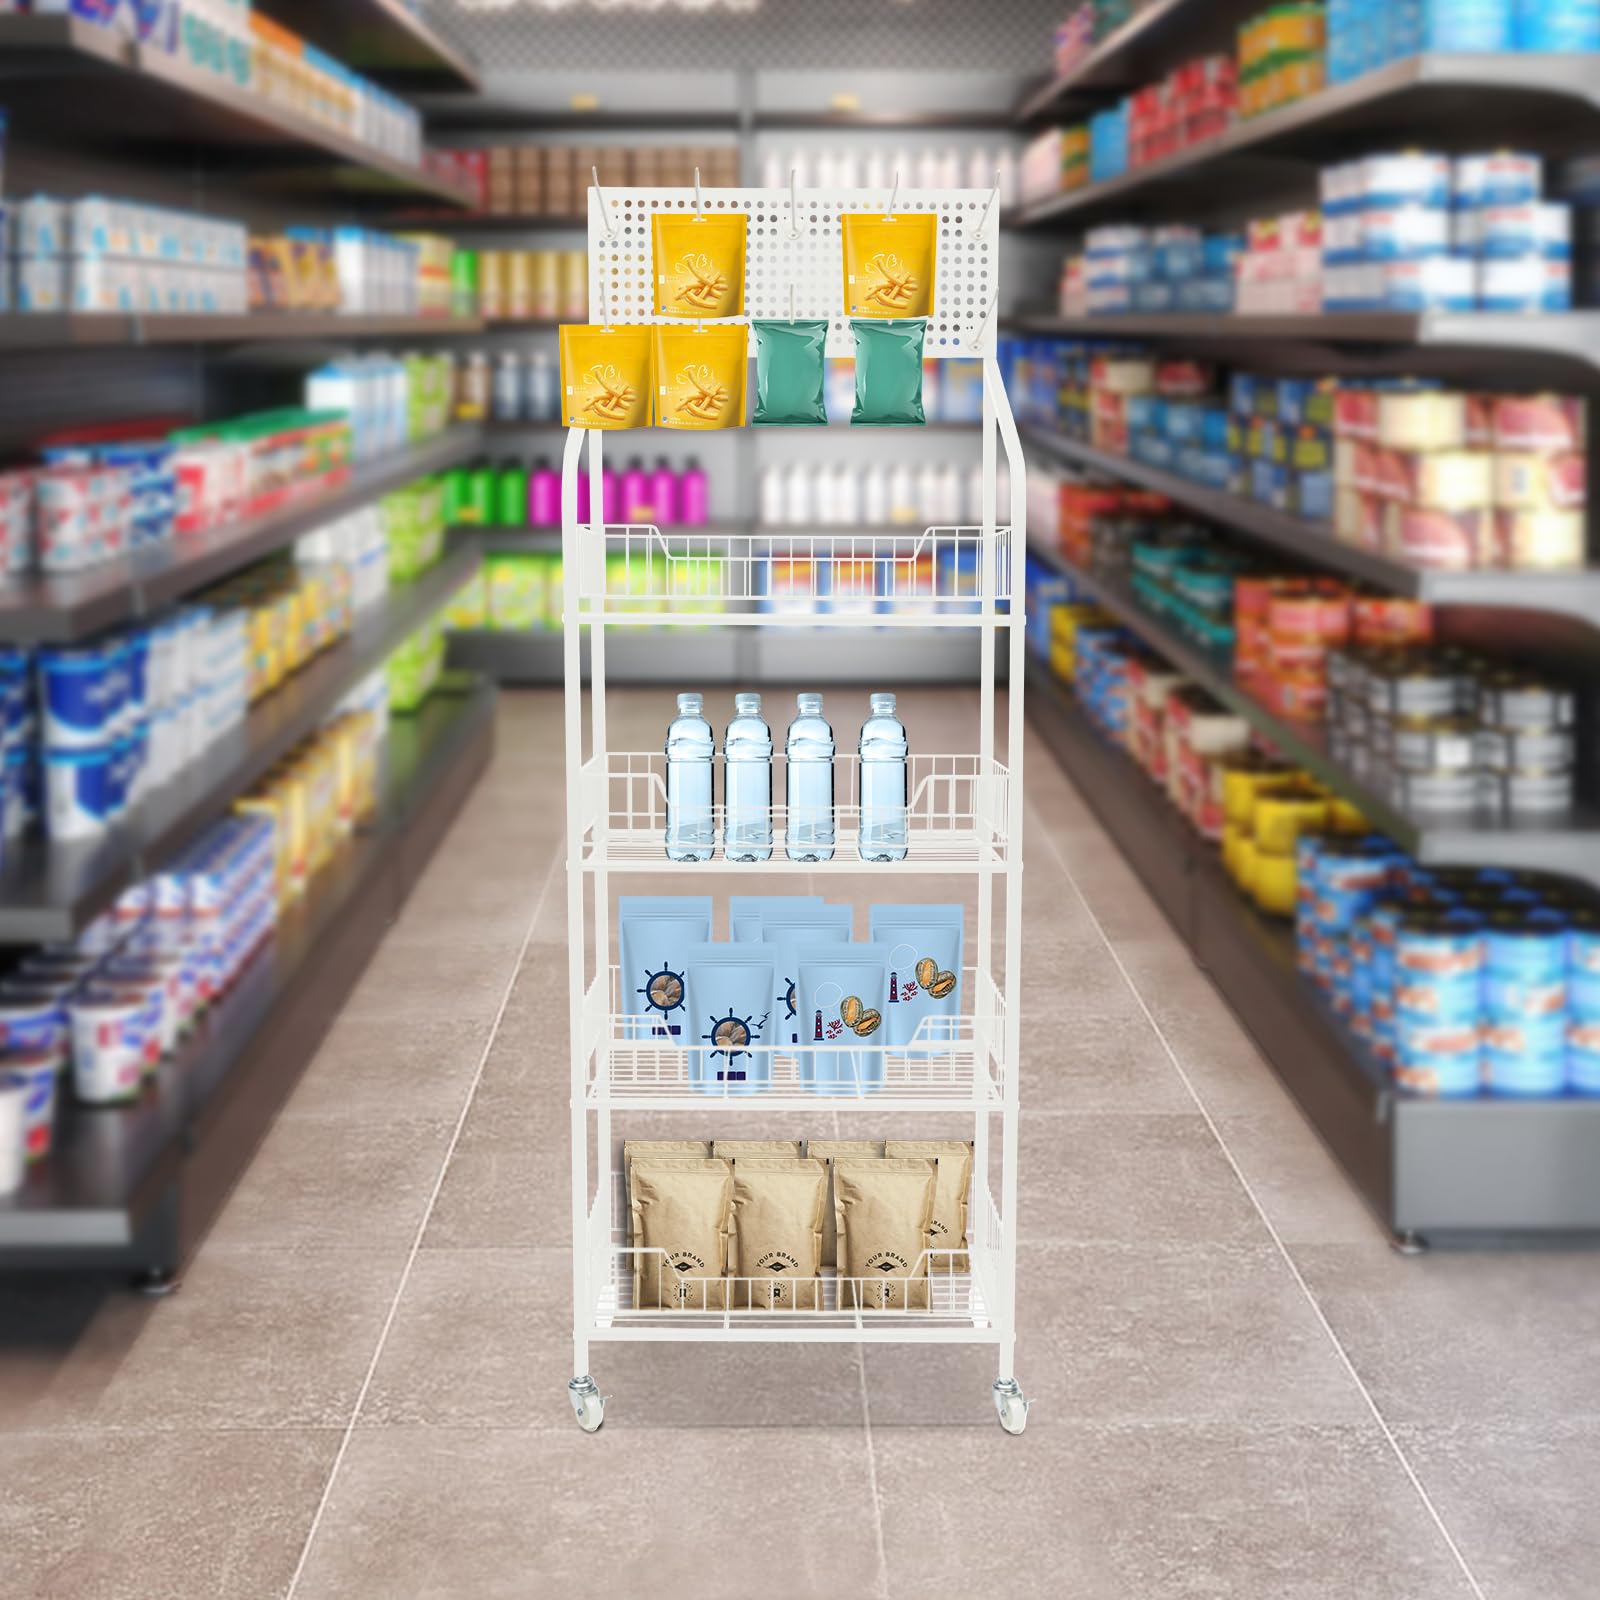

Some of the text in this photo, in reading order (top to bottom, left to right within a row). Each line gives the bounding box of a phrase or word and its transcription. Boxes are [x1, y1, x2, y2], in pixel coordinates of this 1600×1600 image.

[930, 1220, 949, 1234] RAND
[682, 1251, 705, 1268] BRAND
[756, 1252, 774, 1268] YOUR
[776, 1251, 799, 1268] BRAND
[865, 1252, 883, 1268] YOUR
[885, 1251, 908, 1268] BRAND
